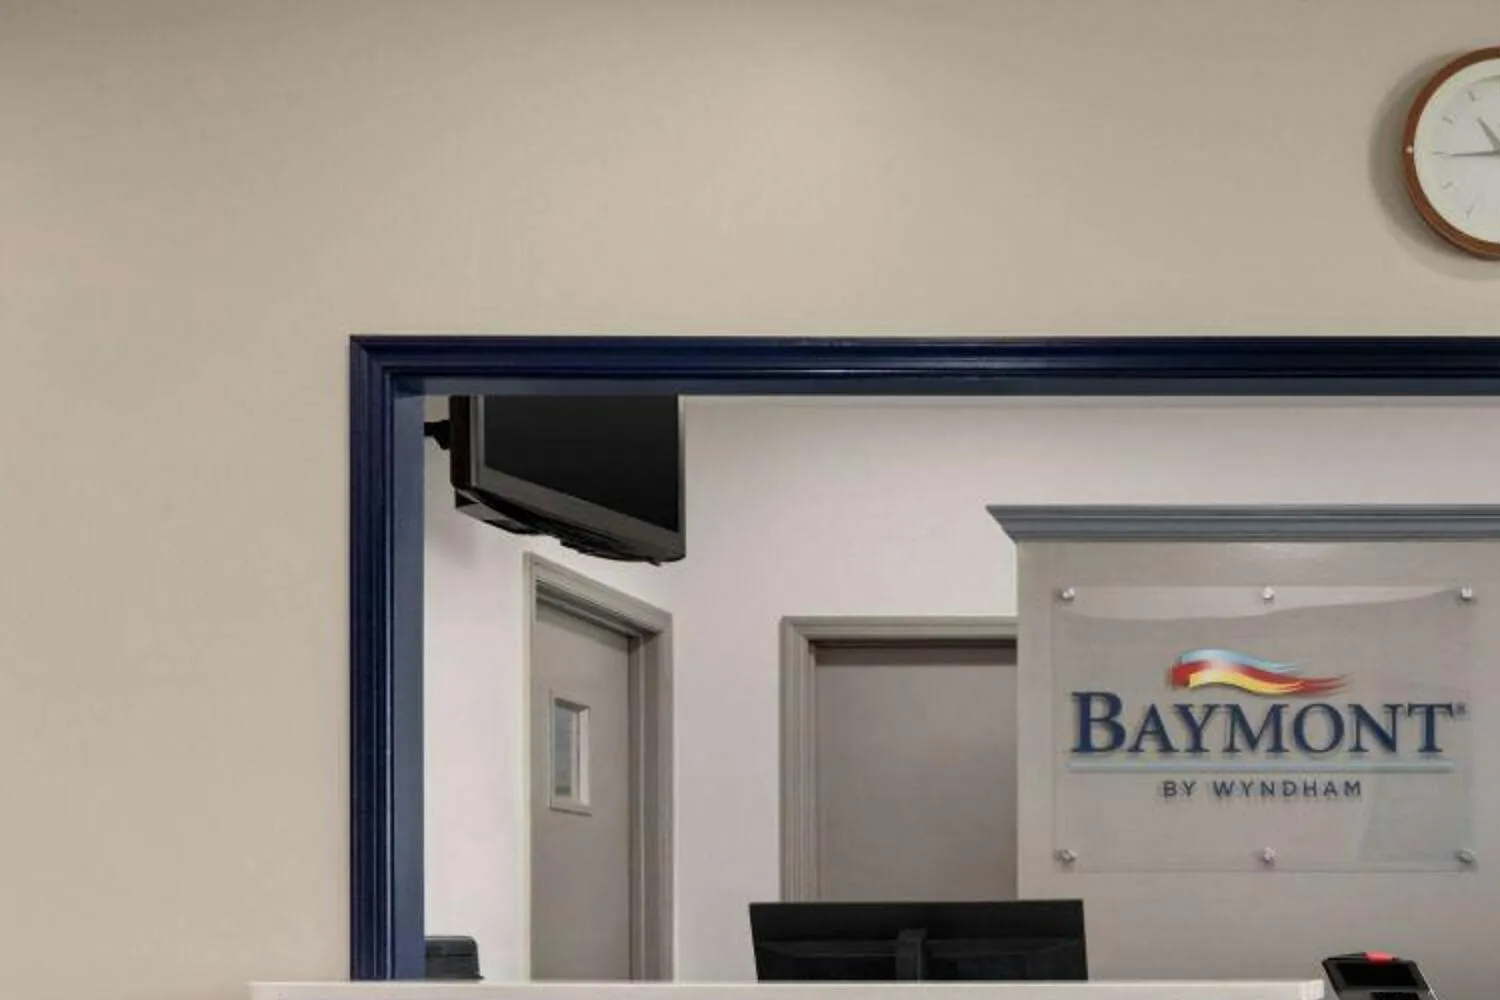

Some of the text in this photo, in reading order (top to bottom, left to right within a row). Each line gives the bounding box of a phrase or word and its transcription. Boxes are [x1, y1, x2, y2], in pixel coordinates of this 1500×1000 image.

[1070, 691, 1455, 756] BAYMONT
[1162, 780, 1363, 798] BY WYNDHAM
